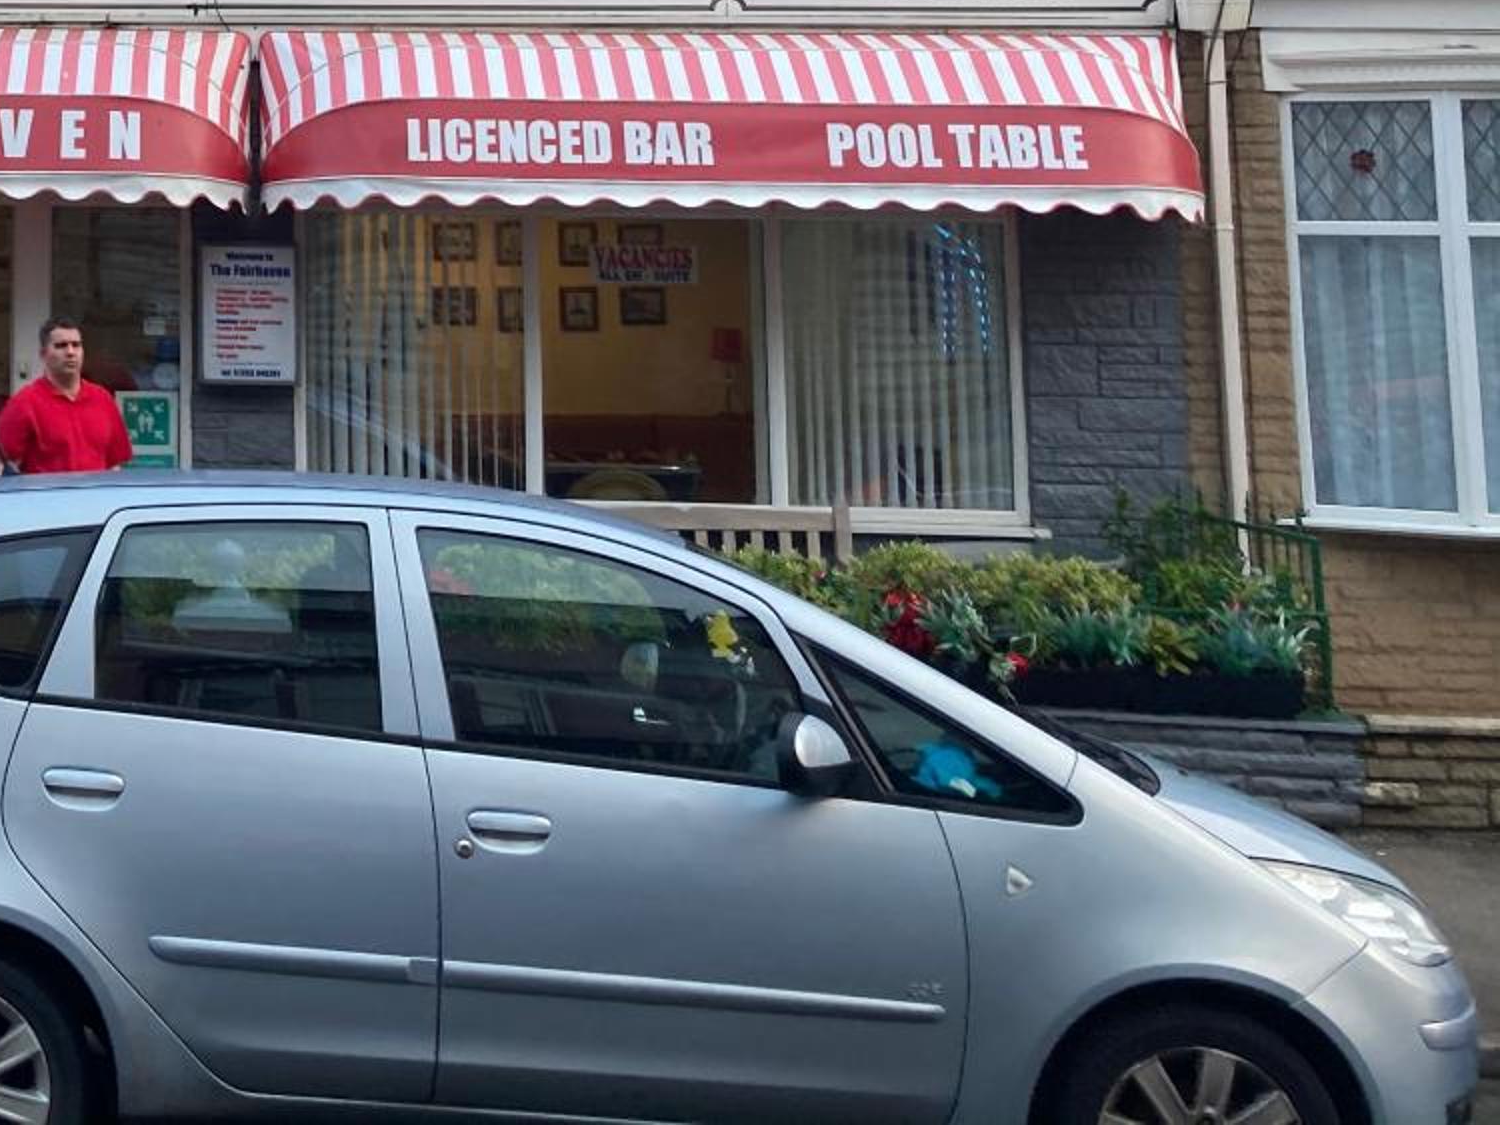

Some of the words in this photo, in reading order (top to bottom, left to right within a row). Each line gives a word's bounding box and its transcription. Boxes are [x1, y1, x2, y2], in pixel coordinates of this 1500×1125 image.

[406, 119, 613, 165] LICENCED
[625, 121, 715, 167] BAR
[826, 123, 943, 169] POOL
[948, 124, 1089, 171] TABLE
[596, 247, 693, 269] VACANCIES
